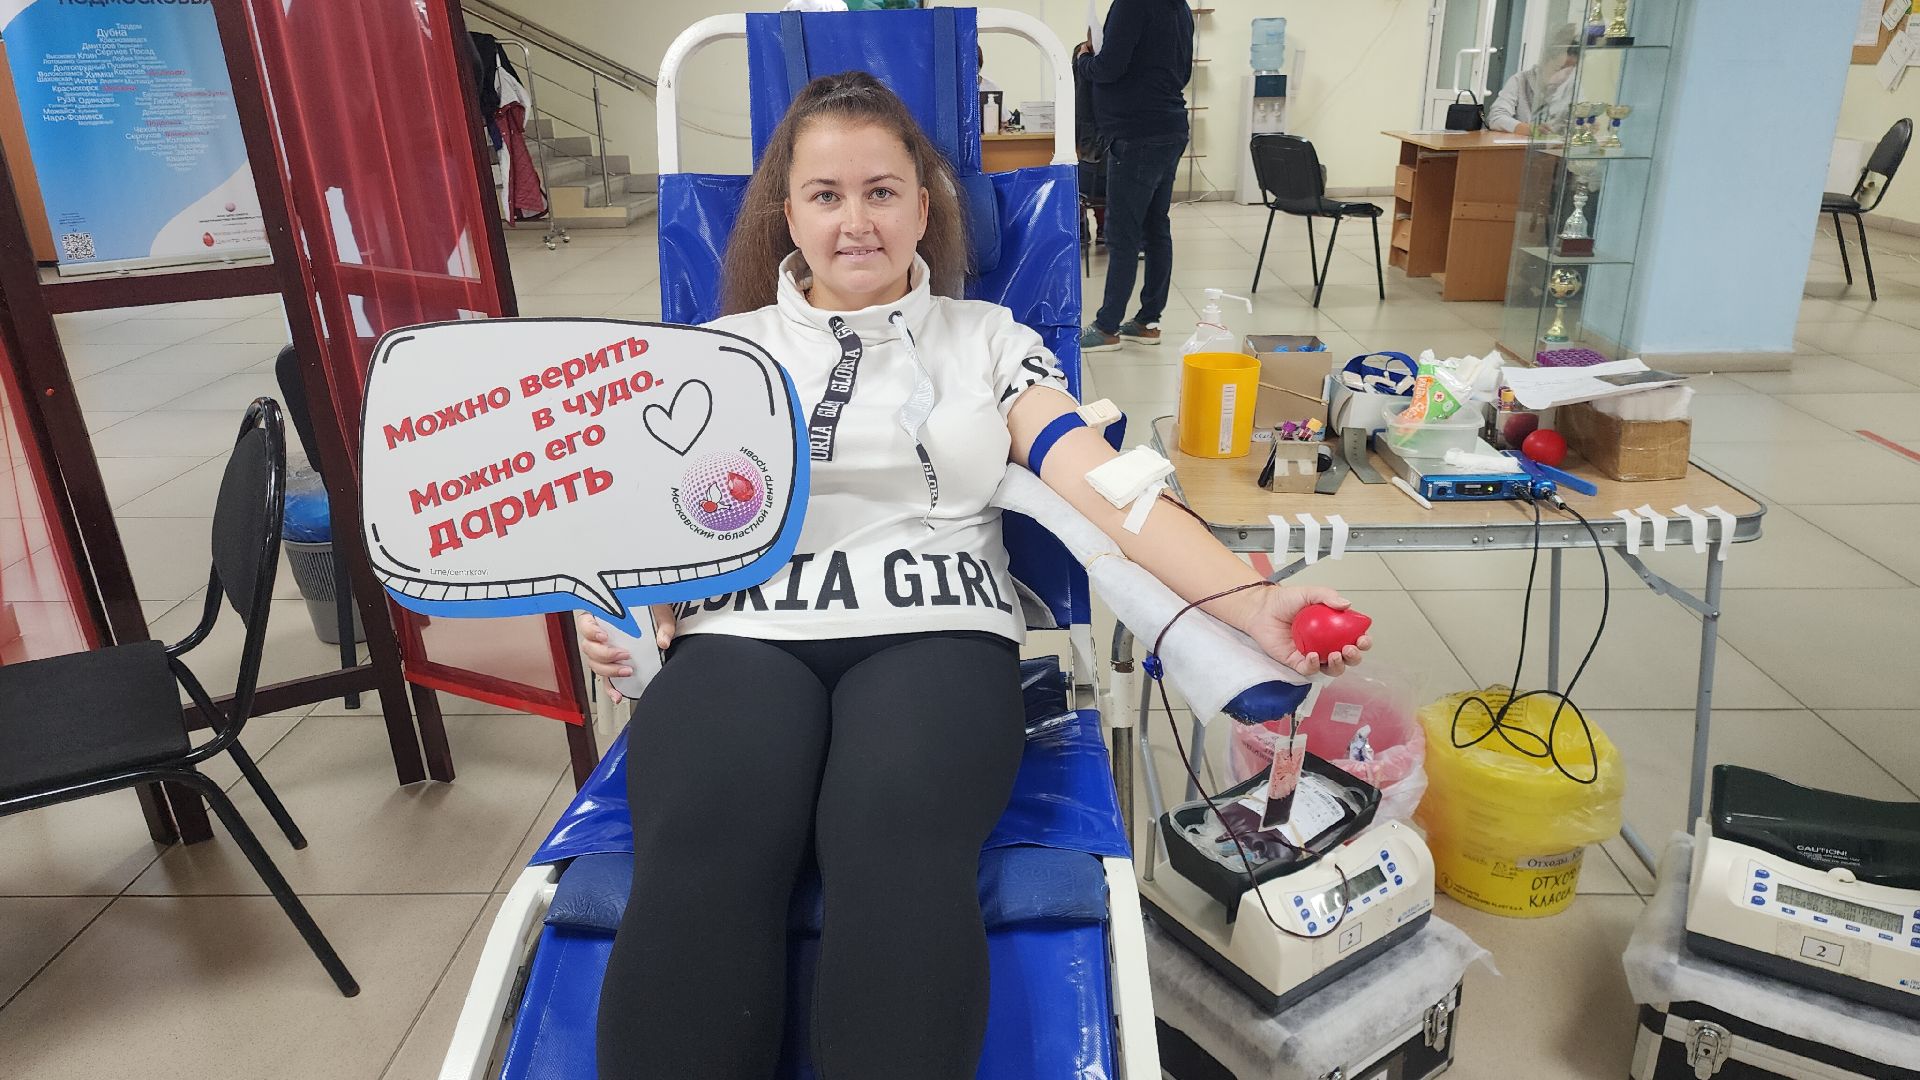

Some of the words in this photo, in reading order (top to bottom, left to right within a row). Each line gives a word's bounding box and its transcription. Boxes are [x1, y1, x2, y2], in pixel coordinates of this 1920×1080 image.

[96, 28, 128, 38] Дубна
[77, 51, 97, 60] Клин
[82, 42, 116, 50] Дмитров
[96, 47, 128, 57] Сергиев
[129, 47, 155, 56] Посад
[53, 63, 106, 72] Долгопрудный
[85, 69, 114, 79] Химки
[52, 84, 99, 92] Красногорск
[43, 113, 104, 122] Наро-Фоминск
[831, 348, 860, 393] GLORIA
[383, 386, 511, 451] Можно
[520, 336, 650, 399] верить
[531, 408, 556, 432] в
[563, 369, 664, 418] чудо.
[739, 446, 768, 473] крови
[409, 453, 535, 515] Можно
[545, 424, 606, 462] его
[764, 475, 774, 508] центр
[429, 467, 614, 559] дарить
[671, 487, 715, 540] Московский
[718, 509, 769, 541] областной
[883, 548, 1013, 614] GIRL
[1796, 844, 1848, 856] CAUTION!
[1816, 946, 1827, 957] 2
